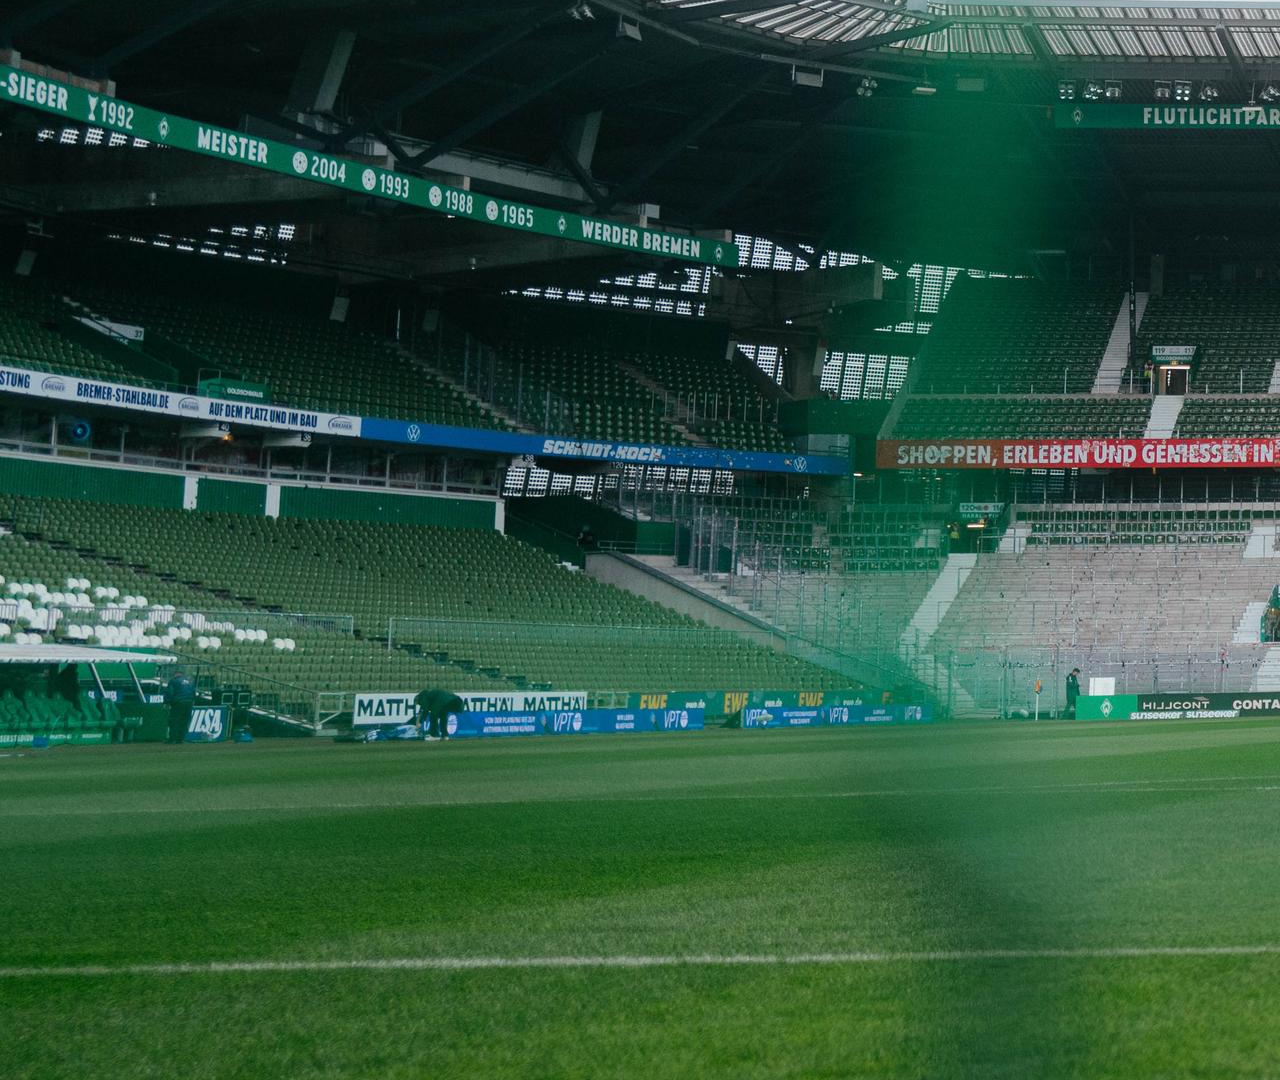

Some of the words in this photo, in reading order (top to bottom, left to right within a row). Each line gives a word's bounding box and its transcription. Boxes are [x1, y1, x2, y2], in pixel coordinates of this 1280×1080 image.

[101, 101, 134, 130] 1992
[197, 126, 268, 165] MEISTER
[311, 156, 346, 184] 2004
[379, 173, 410, 199] 1993
[445, 190, 473, 214] 1988
[502, 204, 534, 228] 1965
[582, 220, 639, 247] WERDER
[642, 230, 701, 258] BREMEN
[76, 383, 169, 410] BREMER-STAHLBAU.DE
[209, 401, 224, 417] AUF
[225, 404, 243, 419] DEM
[244, 406, 269, 422] PLATZ
[269, 408, 287, 424] UND
[287, 411, 299, 426] IM
[300, 413, 318, 428] BAU
[897, 445, 998, 466] SHOPPEN,
[1003, 444, 1087, 464] ERLEBEN
[1094, 444, 1136, 464] UND
[1141, 443, 1248, 464] GENIESSEN
[1253, 443, 1274, 464] IN
[1130, 711, 1184, 720] sunseeker
[1185, 709, 1239, 719] sunseeker
